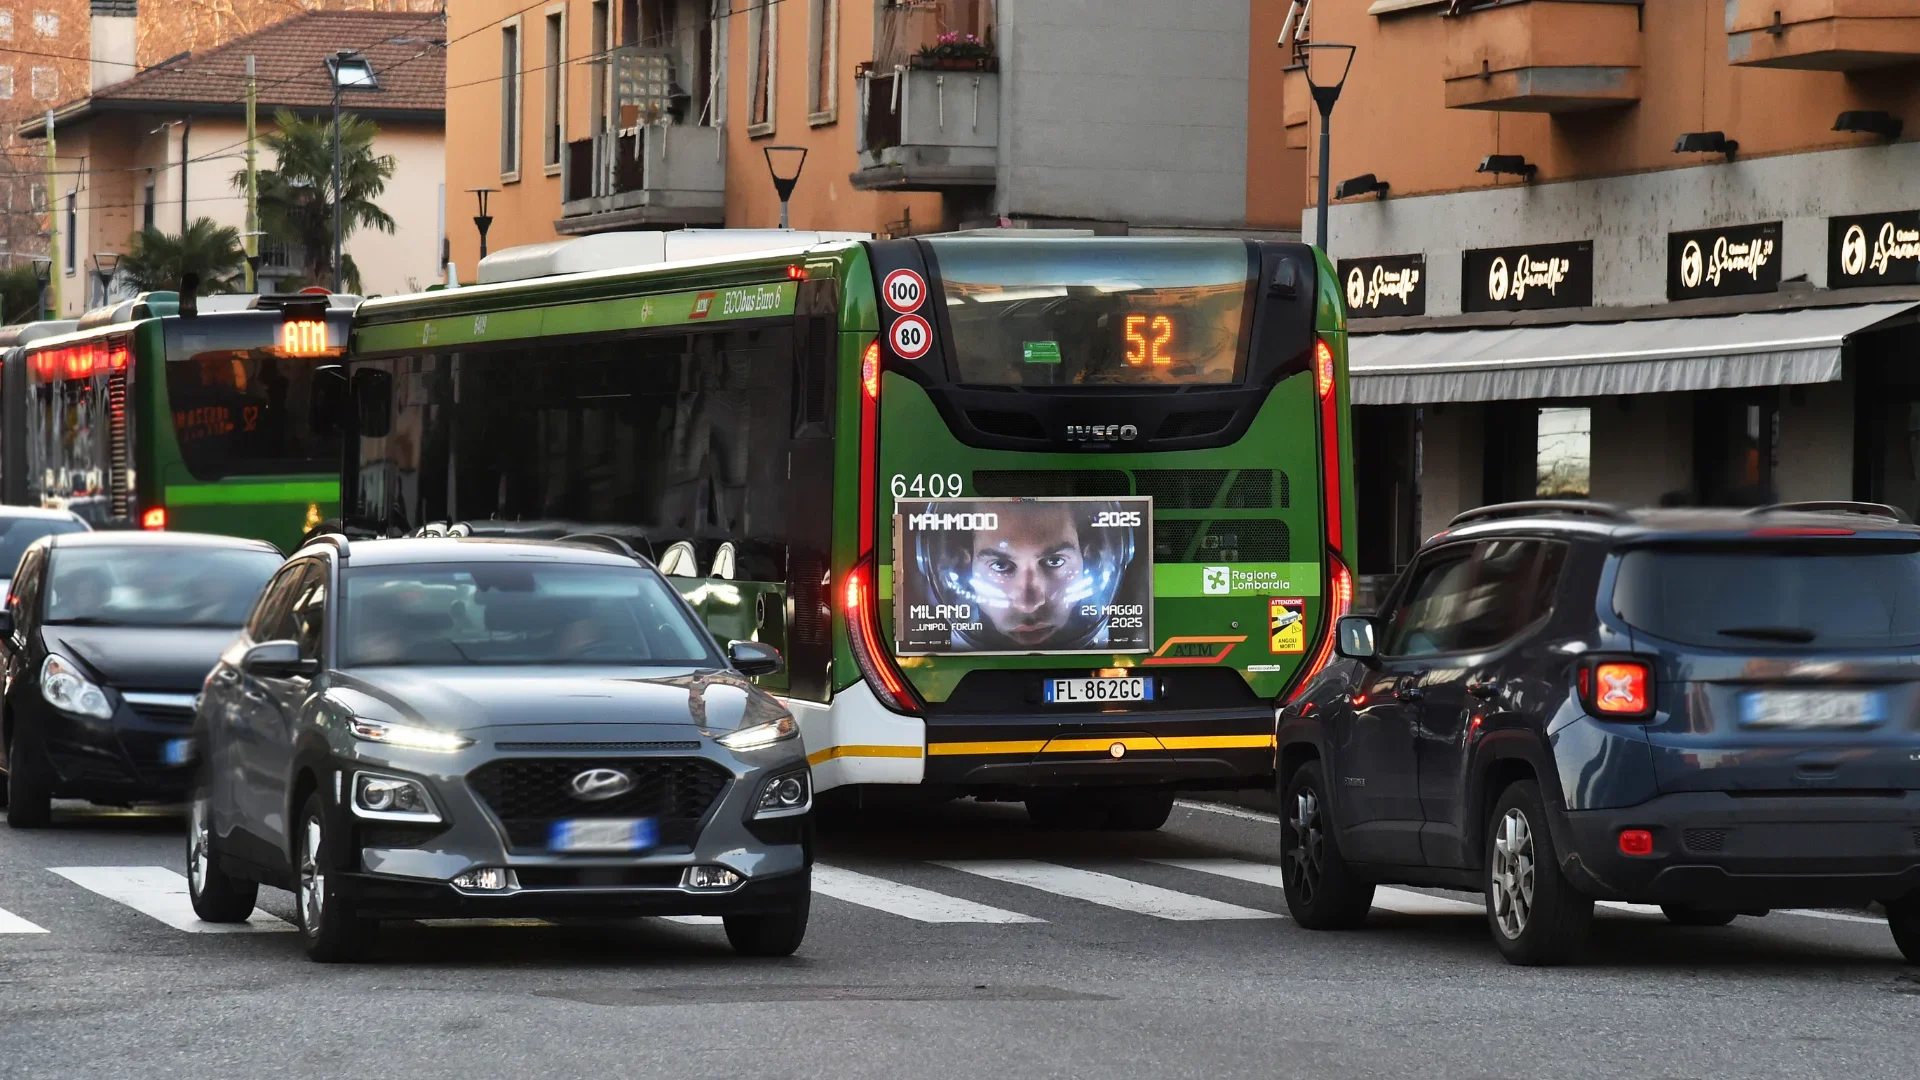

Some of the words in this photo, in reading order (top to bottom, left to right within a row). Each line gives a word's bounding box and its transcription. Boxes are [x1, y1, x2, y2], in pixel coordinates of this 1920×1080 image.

[723, 290, 756, 314] ECObus
[755, 287, 774, 310] Euro
[775, 285, 781, 309] 6
[891, 282, 918, 300] 100
[284, 320, 326, 352] ATM
[901, 328, 920, 345] 80
[1126, 316, 1171, 364] 52
[1066, 424, 1138, 441] IVECO
[890, 473, 963, 498] 6409
[908, 513, 999, 531] MAHMOOD
[1232, 570, 1277, 581] Regione
[1232, 579, 1290, 590] Lombardia
[910, 604, 971, 620] MILANO
[1081, 605, 1098, 615] 25
[1102, 604, 1143, 615] MAGGIO
[951, 622, 983, 631] FORUM
[1173, 643, 1214, 657] ATM
[1056, 680, 1078, 700] FL
[1085, 679, 1141, 699] 862GC
